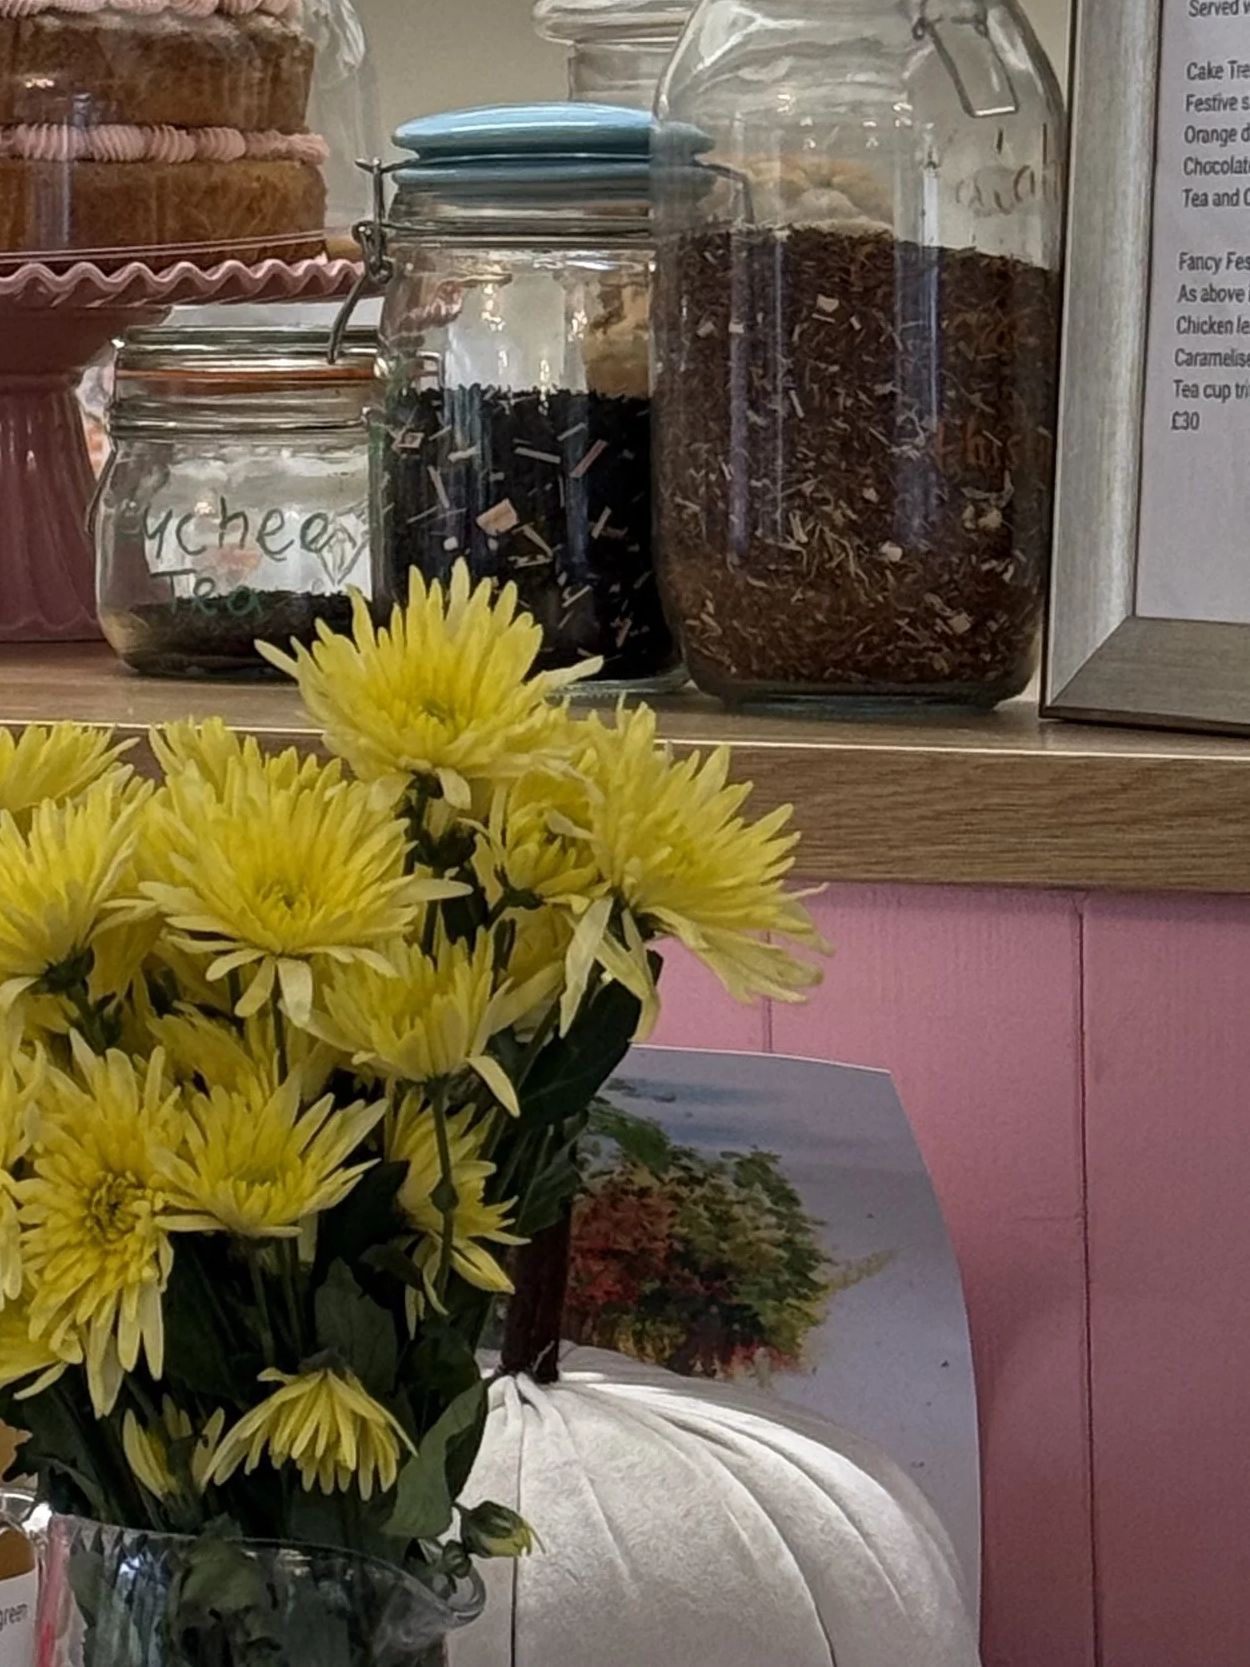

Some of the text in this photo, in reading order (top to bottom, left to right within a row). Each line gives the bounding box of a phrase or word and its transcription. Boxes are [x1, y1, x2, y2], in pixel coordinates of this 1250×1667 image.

[1186, 60, 1224, 81] Cake
[1184, 93, 1238, 113] Festive
[1183, 125, 1238, 148] Orange
[1181, 188, 1208, 208] Tea
[1211, 187, 1240, 207] and
[1178, 251, 1222, 275] Fancy
[1177, 284, 1197, 303] As
[1200, 284, 1245, 302] above
[1176, 315, 1233, 335] Chicken
[1172, 379, 1250, 404] Tea cup tri
[1170, 411, 1201, 432] £30
[118, 495, 330, 562] ychee
[149, 567, 265, 619] Tea
